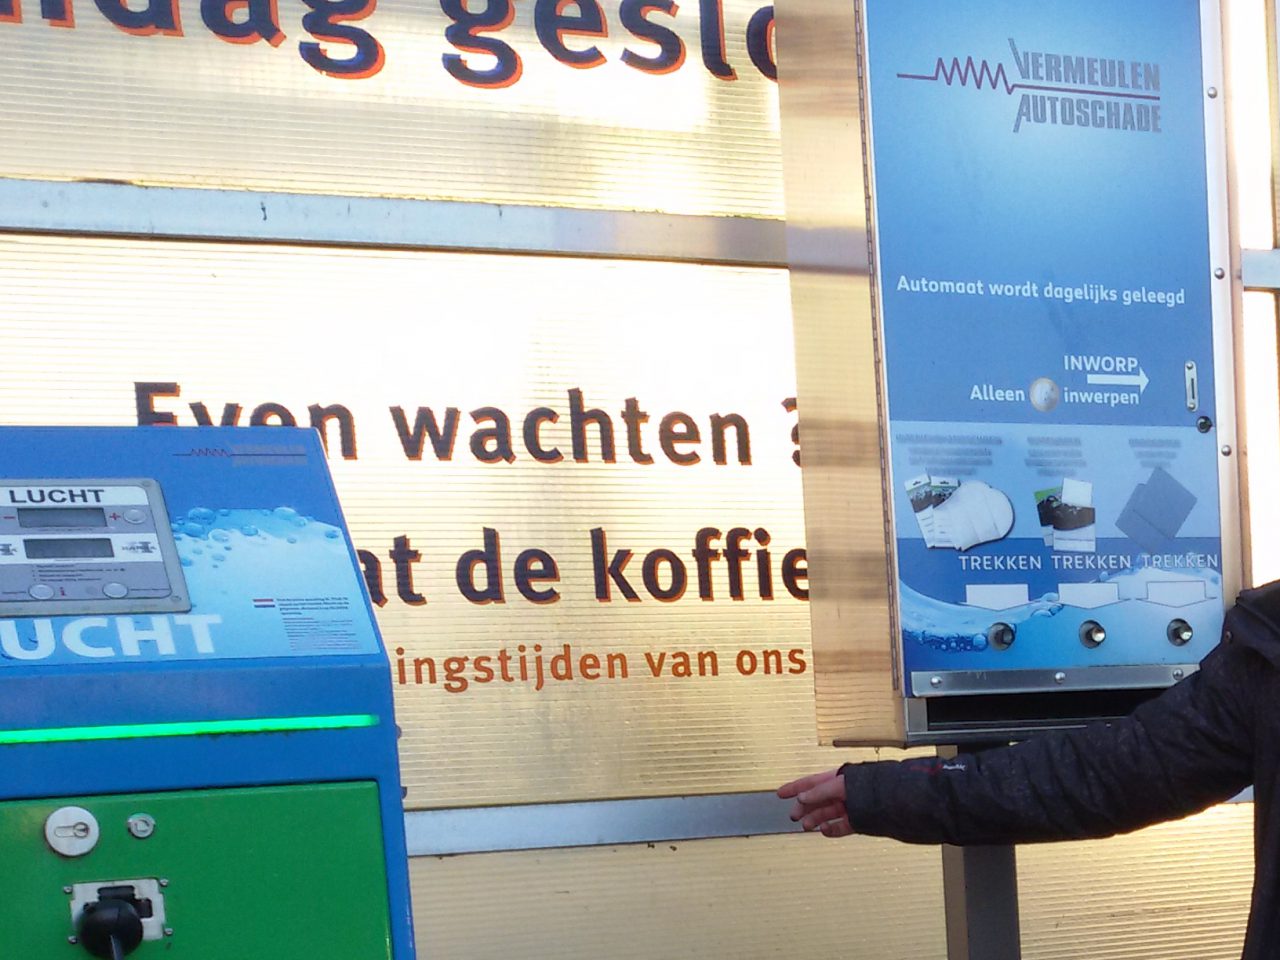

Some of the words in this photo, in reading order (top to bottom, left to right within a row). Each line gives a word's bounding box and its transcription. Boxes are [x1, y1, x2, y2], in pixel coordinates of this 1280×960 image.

[1008, 38, 1160, 91] VERMEULEN
[1013, 93, 1162, 133] AUTOSCHADE
[897, 275, 984, 295] Automaat
[989, 281, 1038, 298] wordt
[1043, 282, 1118, 303] dagelijks
[1122, 287, 1185, 307] geleegd
[1063, 355, 1139, 373] INWORP
[970, 384, 1026, 402] Alleen
[1063, 386, 1140, 406] inwerpen
[390, 387, 753, 466] wachten
[8, 489, 105, 504] LUCHT
[455, 527, 561, 606] de
[590, 527, 810, 603] koffie
[958, 555, 1042, 571] TREKKEN
[1051, 554, 1131, 570] TREKKEN
[1141, 553, 1219, 569] TREKKEN
[645, 649, 718, 678] van
[736, 648, 808, 676] ons
